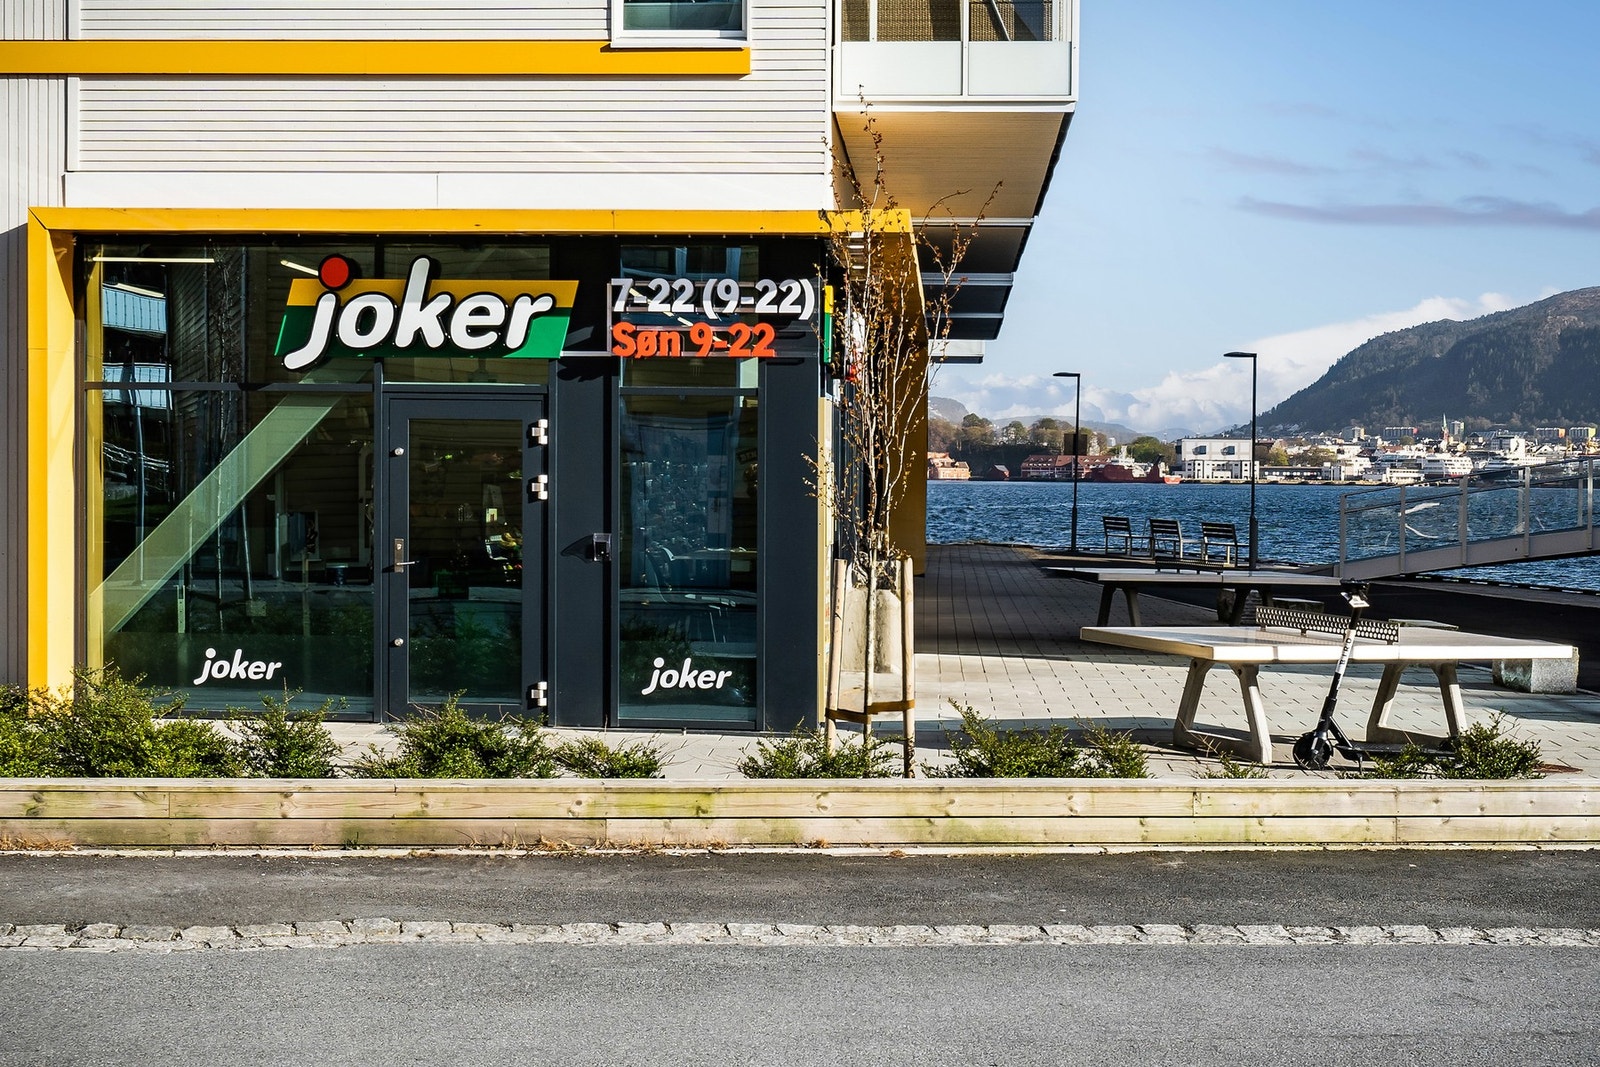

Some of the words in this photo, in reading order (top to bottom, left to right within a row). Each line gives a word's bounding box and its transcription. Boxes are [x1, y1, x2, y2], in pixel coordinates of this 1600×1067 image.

[283, 255, 554, 371] joker
[611, 278, 694, 312] 7-22
[703, 278, 816, 320] (9-22)
[612, 322, 681, 358] Søn
[689, 322, 775, 358] 9-22
[193, 648, 282, 686] joker
[1339, 637, 1352, 664] BIRD
[642, 657, 733, 696] joker
